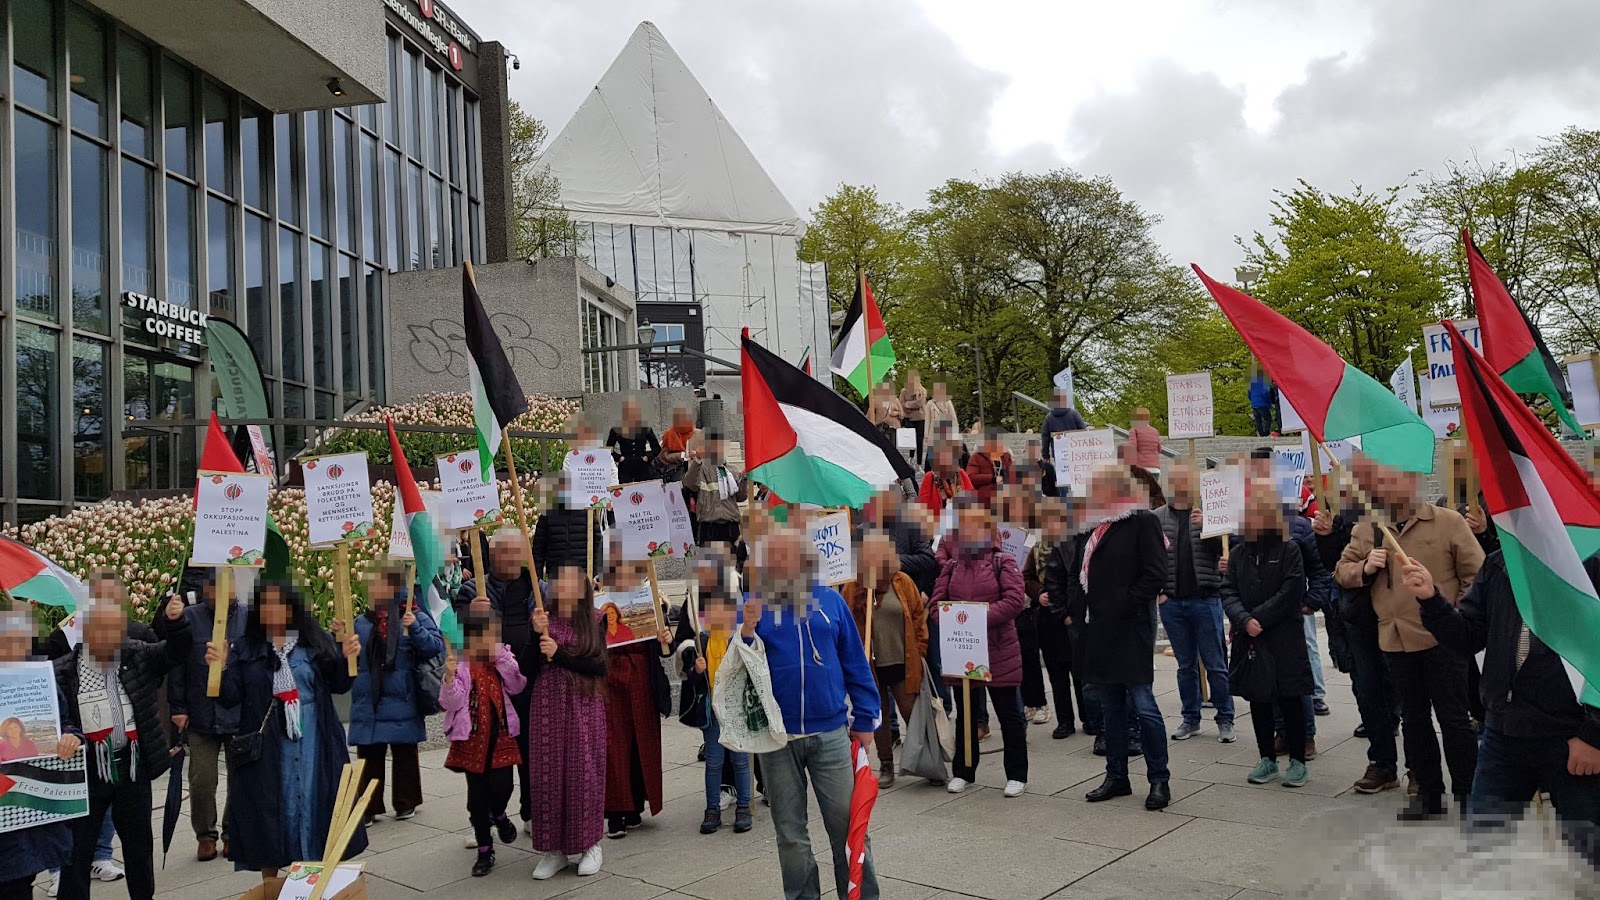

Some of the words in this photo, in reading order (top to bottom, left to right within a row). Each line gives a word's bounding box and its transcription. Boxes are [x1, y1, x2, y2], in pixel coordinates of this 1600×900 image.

[433, 6, 471, 50] SR-Bank
[128, 291, 207, 328] STARBUCK
[146, 318, 201, 345] COFFEE
[1168, 380, 1202, 390] STANS
[1173, 392, 1209, 403] ISRAELS
[1172, 405, 1212, 417] ETNISKE
[1174, 419, 1211, 434] RENSING
[1070, 436, 1102, 448] STANS
[1071, 451, 1111, 462] ISRAELS
[317, 481, 359, 492] SANKSJONER
[317, 494, 361, 504] FOLKERETTEN
[456, 494, 486, 504] PALESTINA
[1205, 486, 1230, 500] ISRAE
[1206, 497, 1229, 510] ETNIS
[318, 512, 366, 522] RETTIGHETENE
[322, 507, 360, 516] MENNESKE-
[1208, 514, 1229, 526] RENS
[19, 782, 39, 792] Free
[43, 788, 86, 796] Palestine
